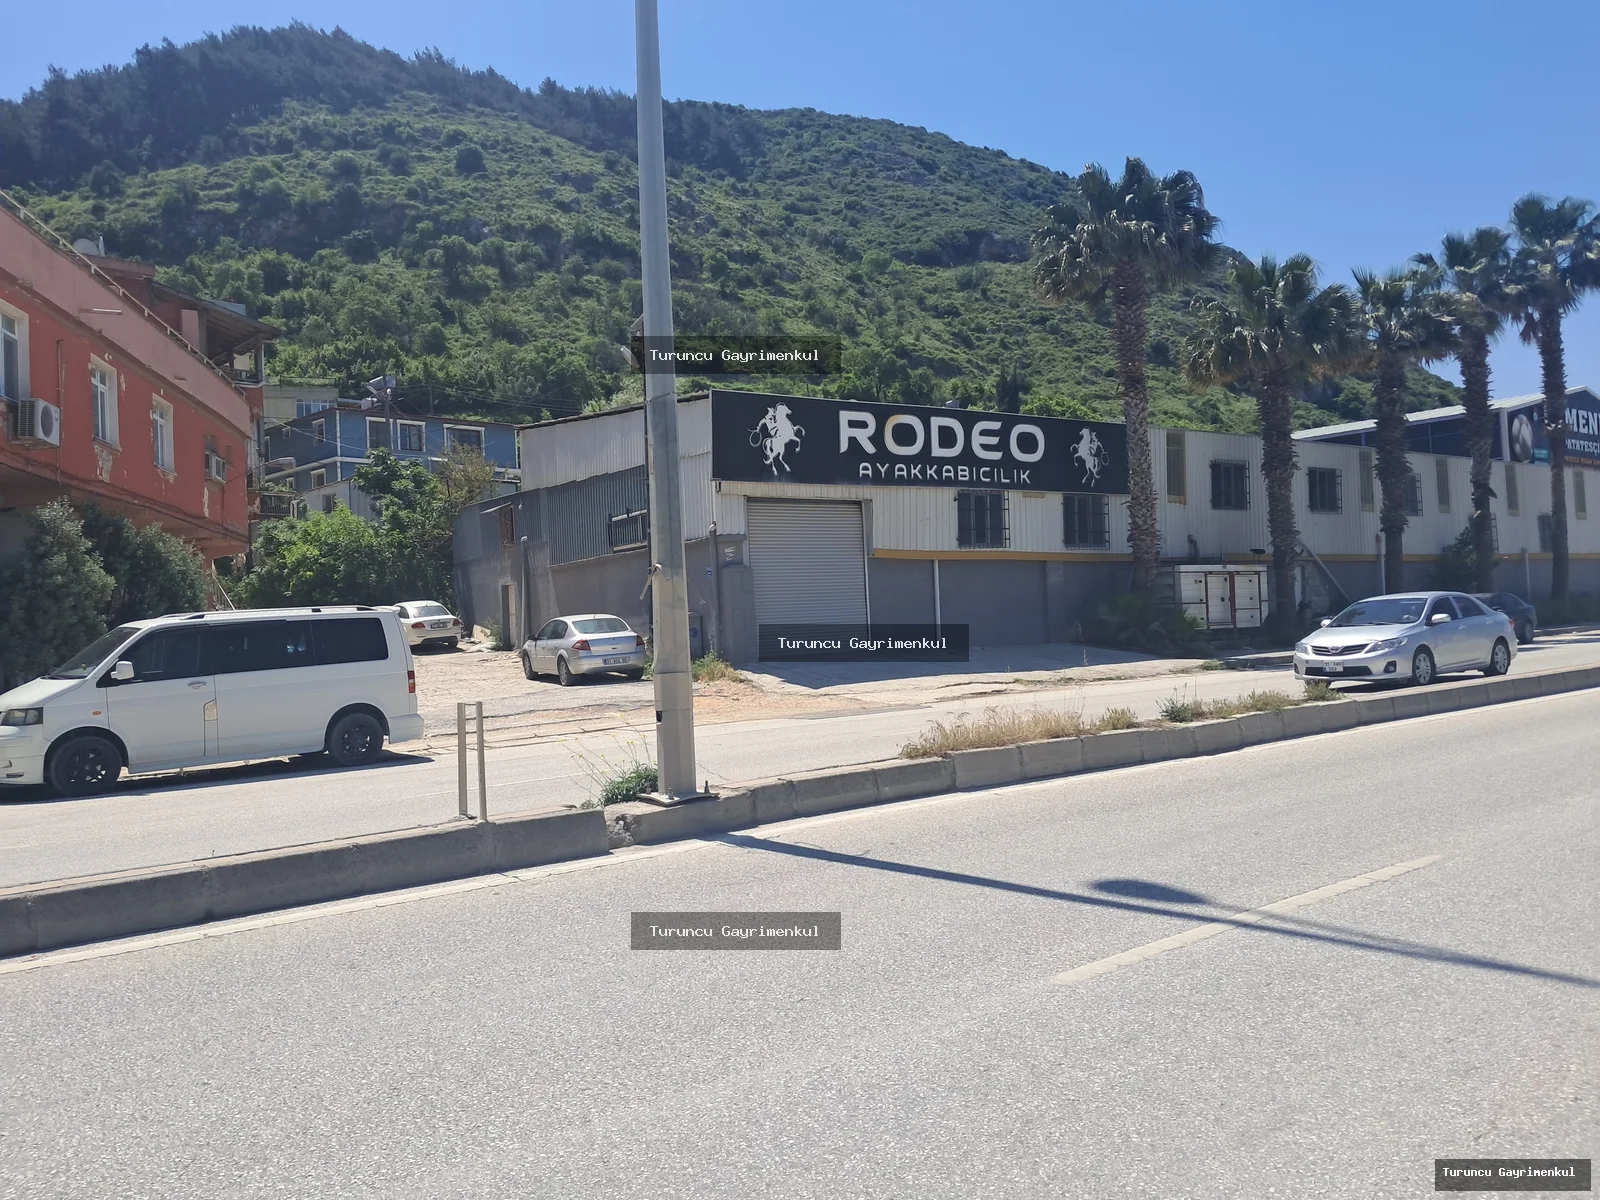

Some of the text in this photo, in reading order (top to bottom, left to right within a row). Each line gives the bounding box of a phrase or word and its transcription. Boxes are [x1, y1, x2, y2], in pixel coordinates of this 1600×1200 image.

[1564, 407, 1600, 436] MEN
[838, 410, 1046, 463] RODEO
[858, 462, 1031, 485] AYAKKABICILIK
